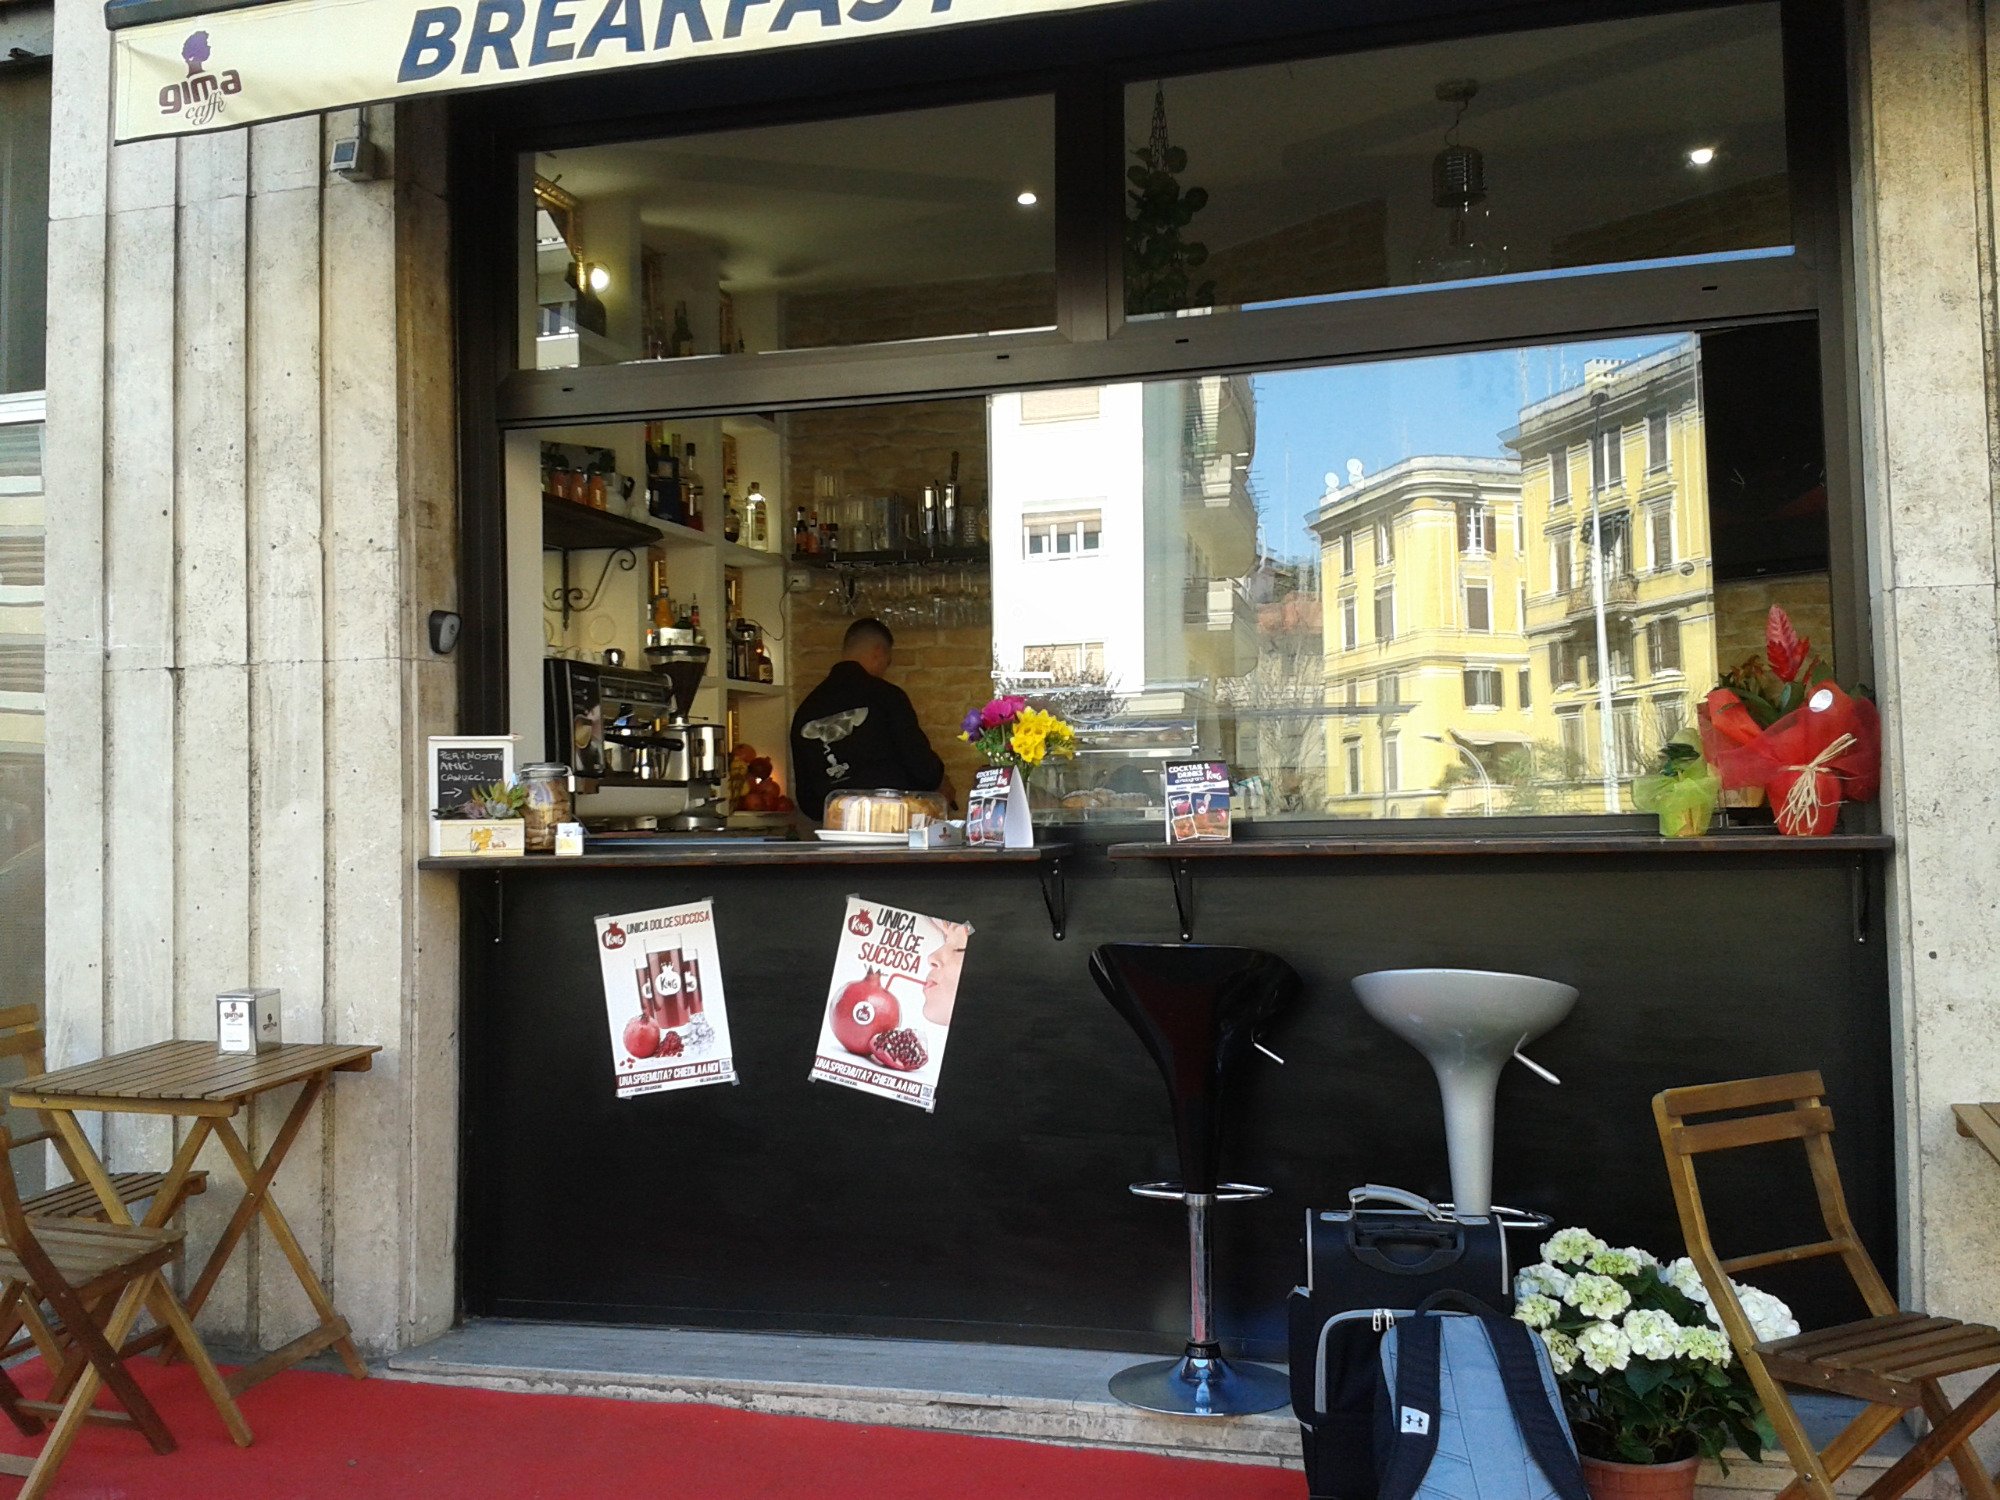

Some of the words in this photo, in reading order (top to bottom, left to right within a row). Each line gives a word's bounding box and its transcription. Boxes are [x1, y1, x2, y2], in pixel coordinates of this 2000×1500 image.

[397, 0, 955, 83] BREAKF
[159, 69, 242, 114] gima
[674, 910, 711, 927] SUCCOSA
[876, 908, 917, 933] UNICA
[879, 928, 924, 954] DOLCE
[858, 942, 921, 974] SUCCOSA
